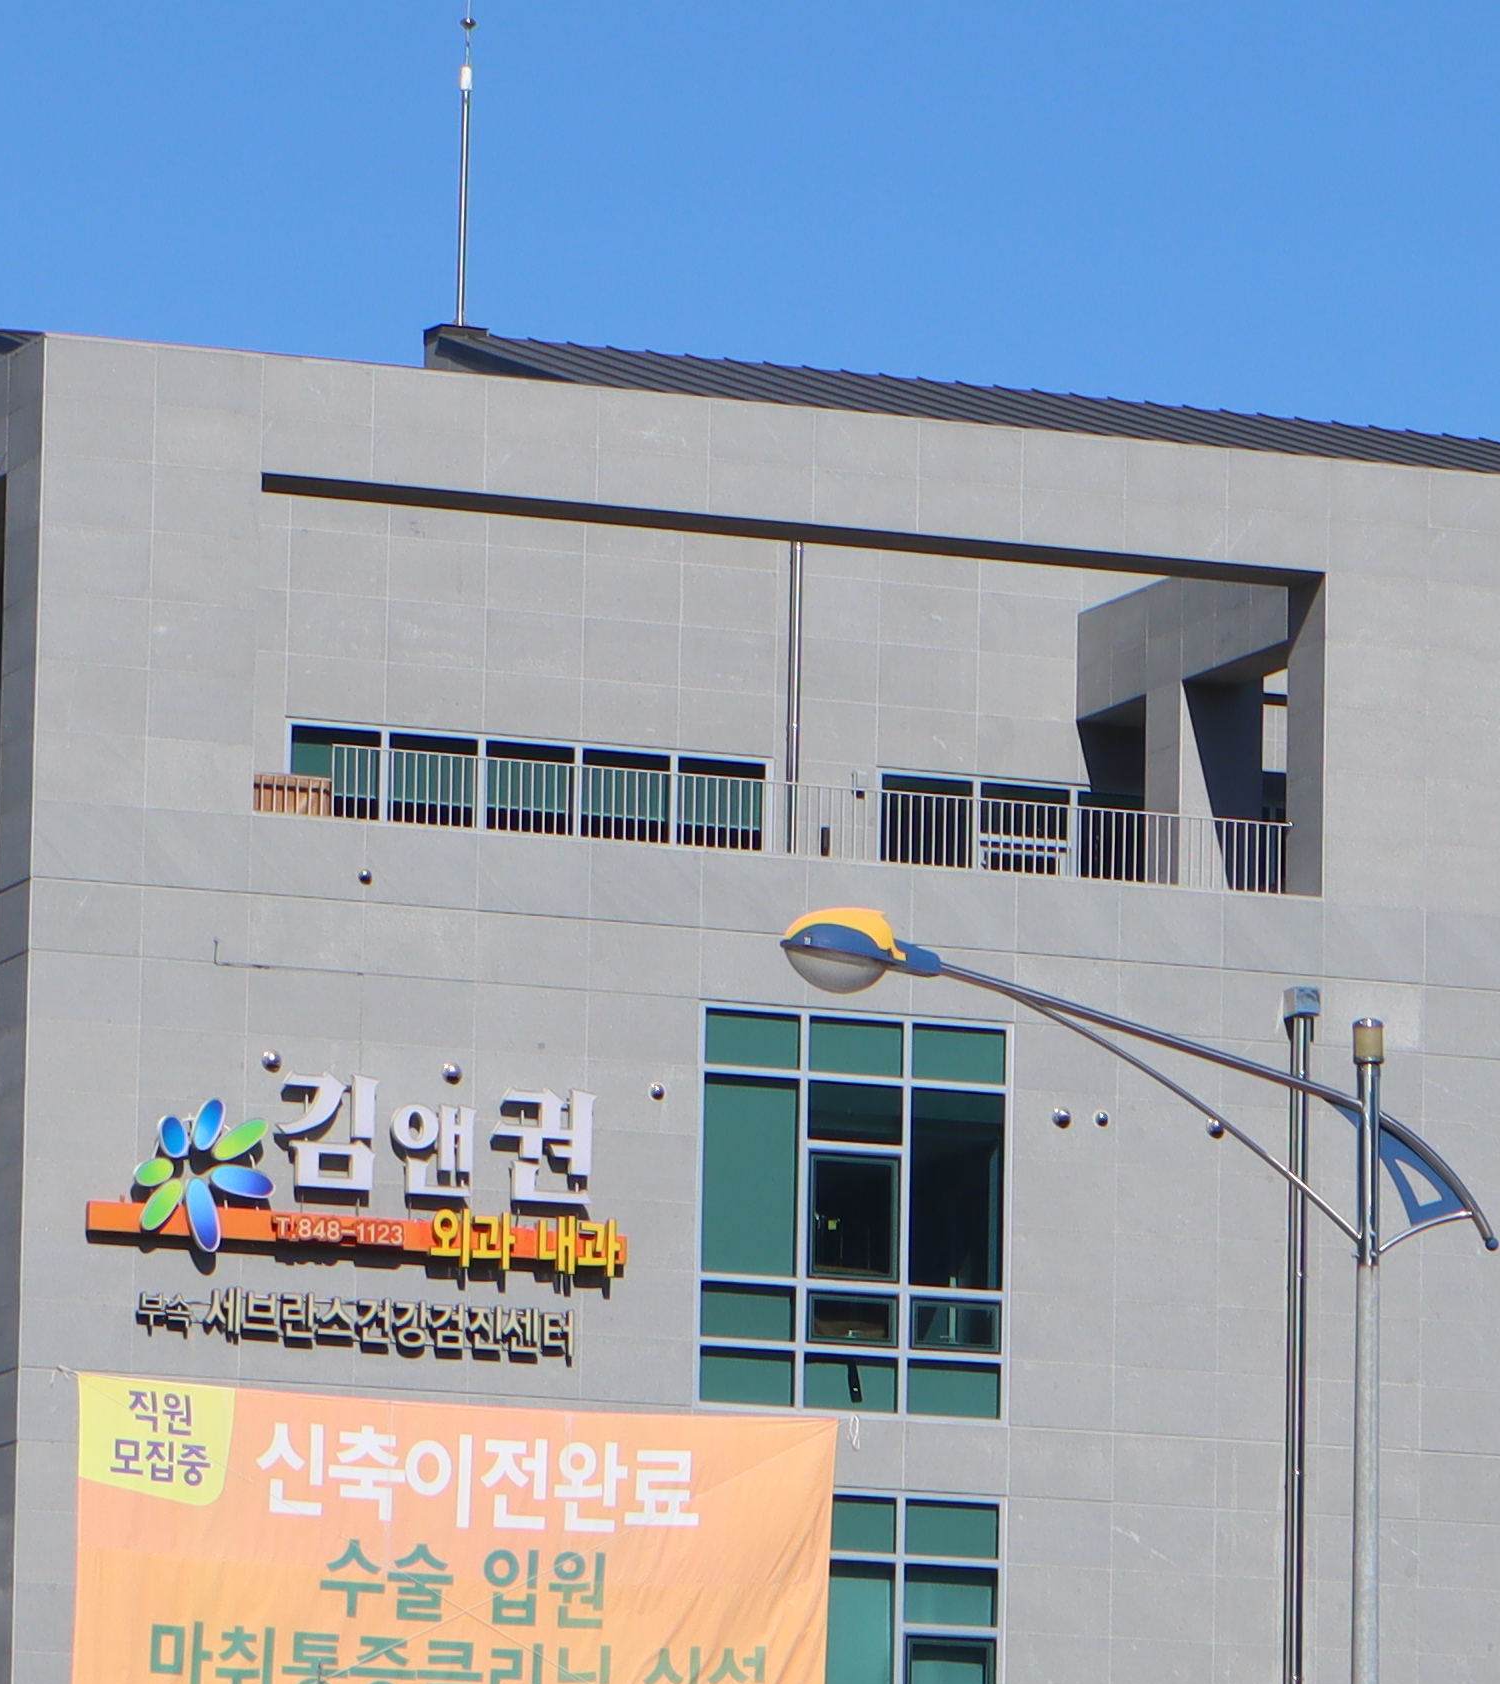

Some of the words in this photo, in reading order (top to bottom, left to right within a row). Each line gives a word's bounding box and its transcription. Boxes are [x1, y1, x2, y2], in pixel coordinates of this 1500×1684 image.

[276, 1072, 598, 1206] 김앤권
[274, 1214, 405, 1247] T.848-1123
[430, 1208, 516, 1271] 외과
[537, 1214, 623, 1279] 내과
[136, 1290, 195, 1330] 부속
[205, 1286, 576, 1358] 세브란스건강검진센터
[127, 1389, 194, 1437] 직원
[109, 1437, 212, 1487] 모집중
[256, 1421, 700, 1534] 신축이전완료
[319, 1538, 454, 1622] 수술
[483, 1548, 607, 1629] 입원
